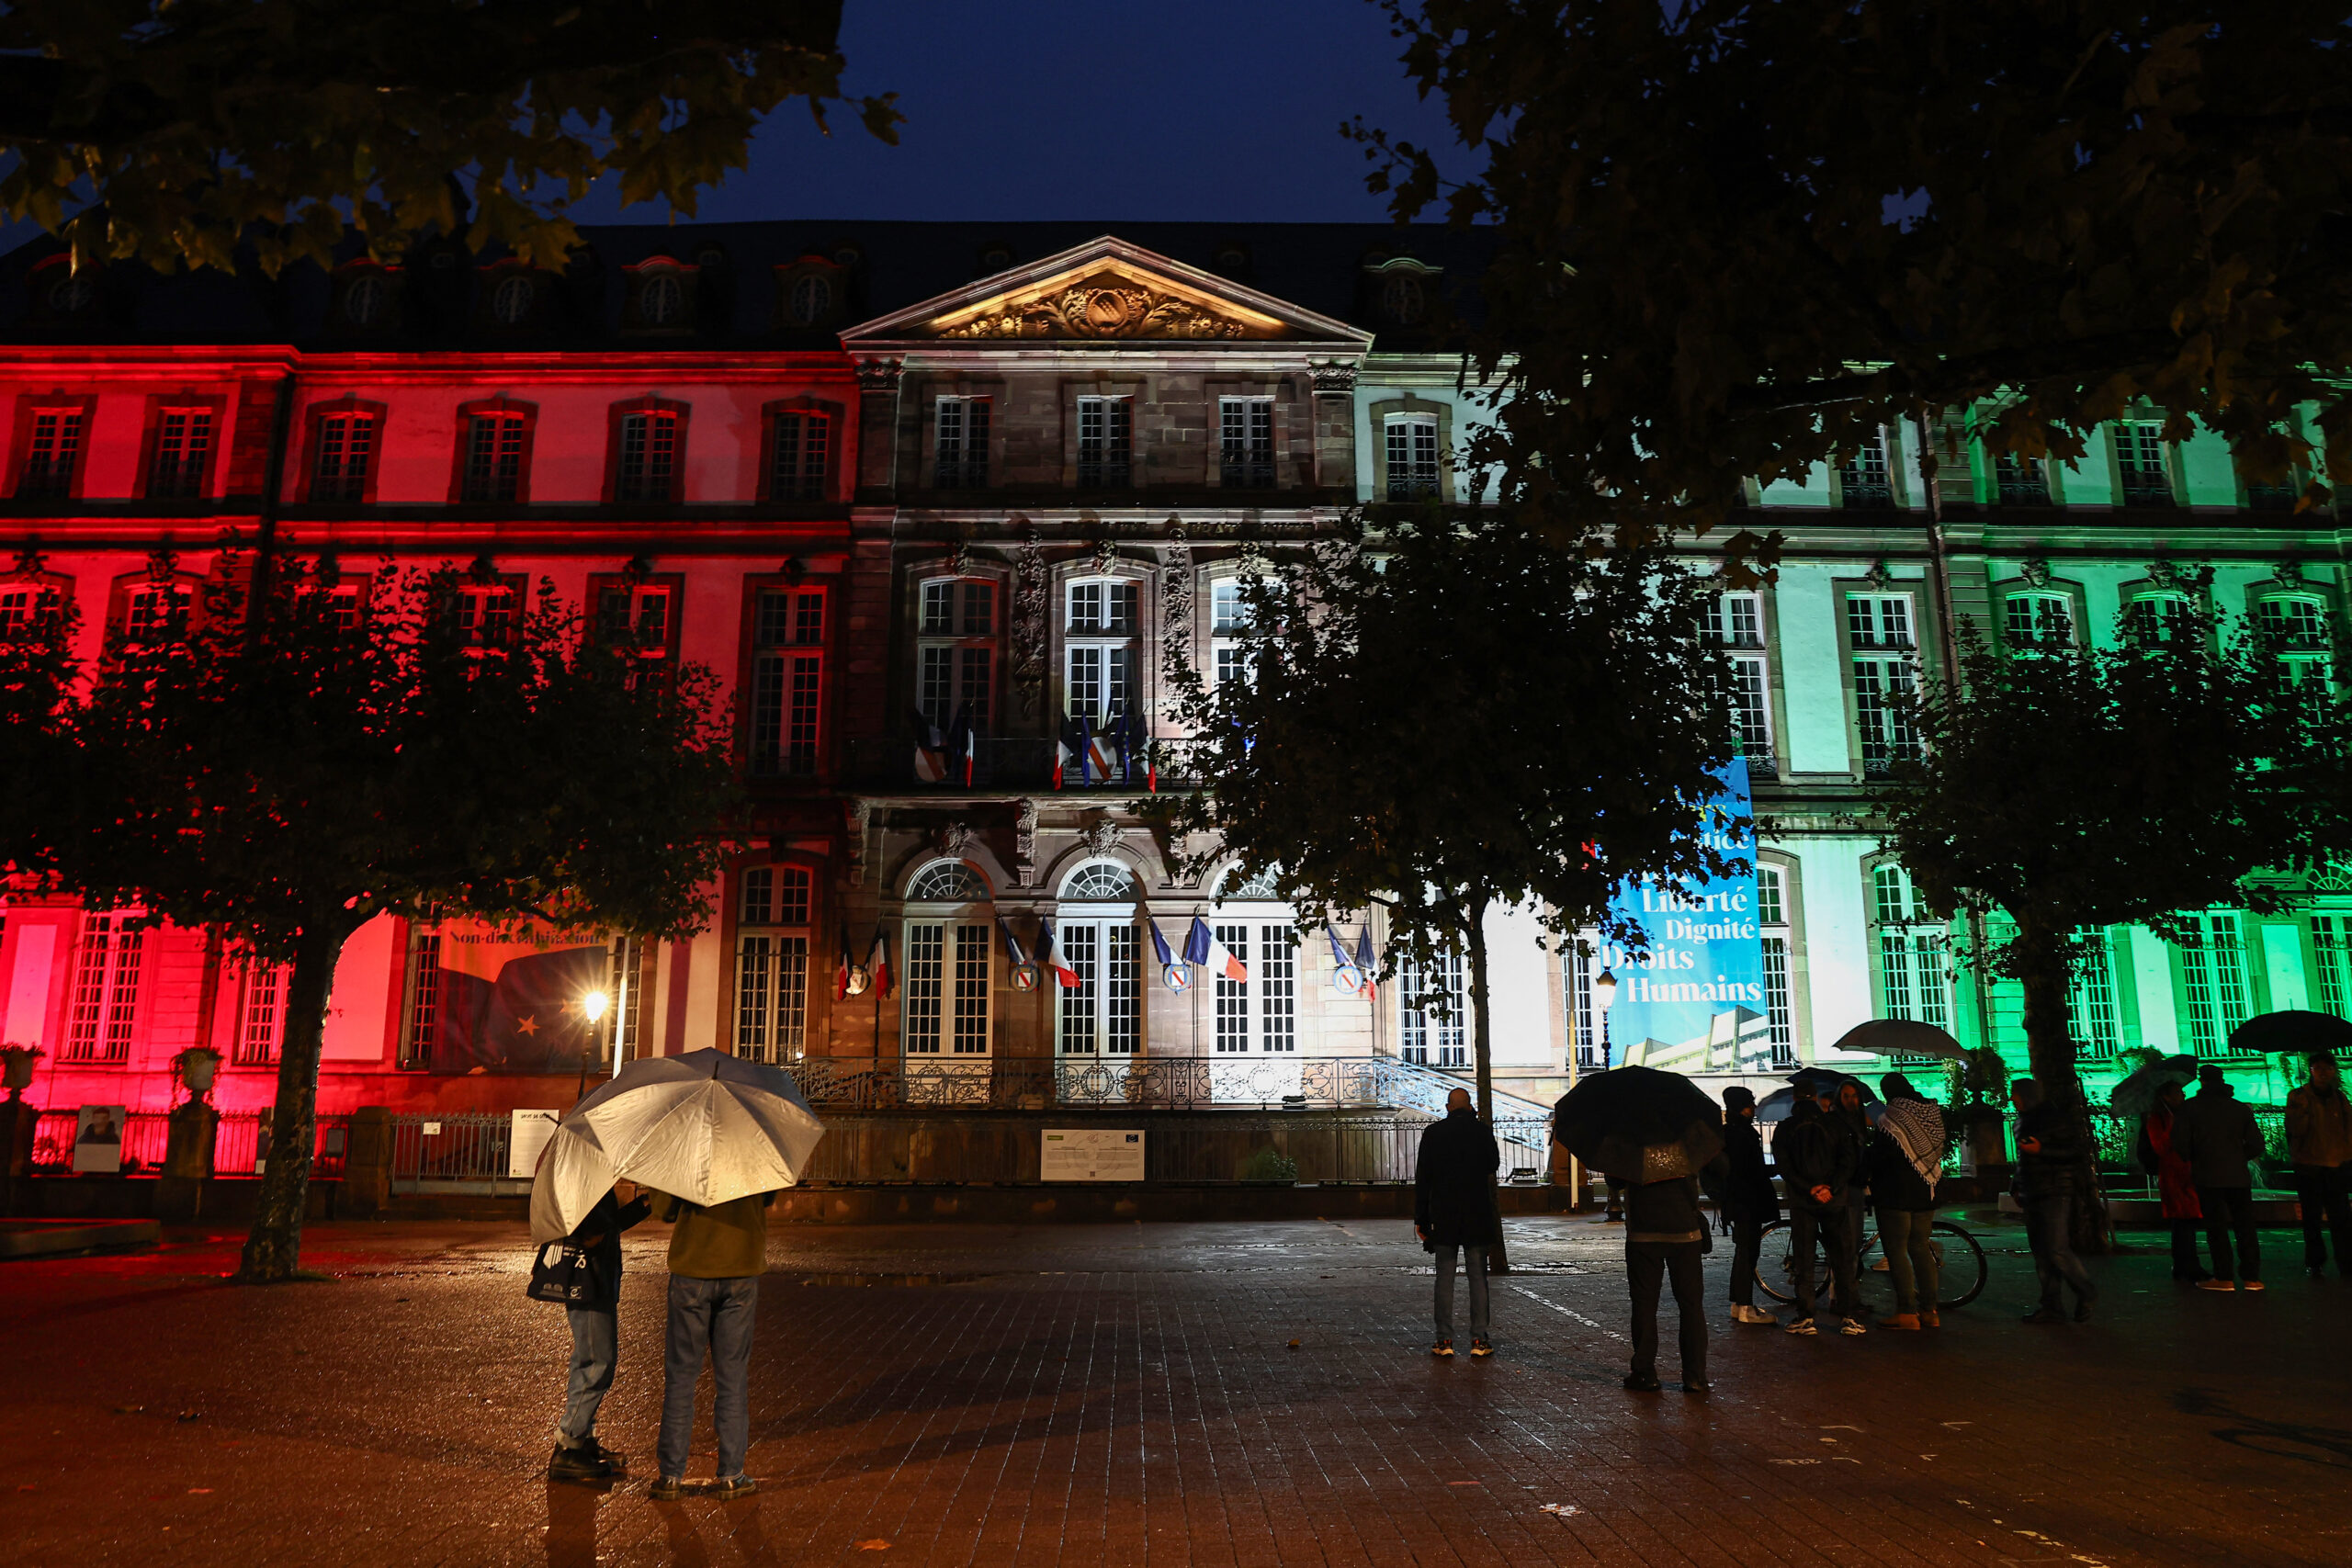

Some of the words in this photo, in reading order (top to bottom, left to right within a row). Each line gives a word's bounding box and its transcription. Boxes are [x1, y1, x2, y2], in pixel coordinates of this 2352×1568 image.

[1642, 886, 1747, 912] Liberté
[1666, 918, 1756, 944] Dignité
[1601, 943, 1695, 970] Droits
[1626, 975, 1762, 1002] Humains
